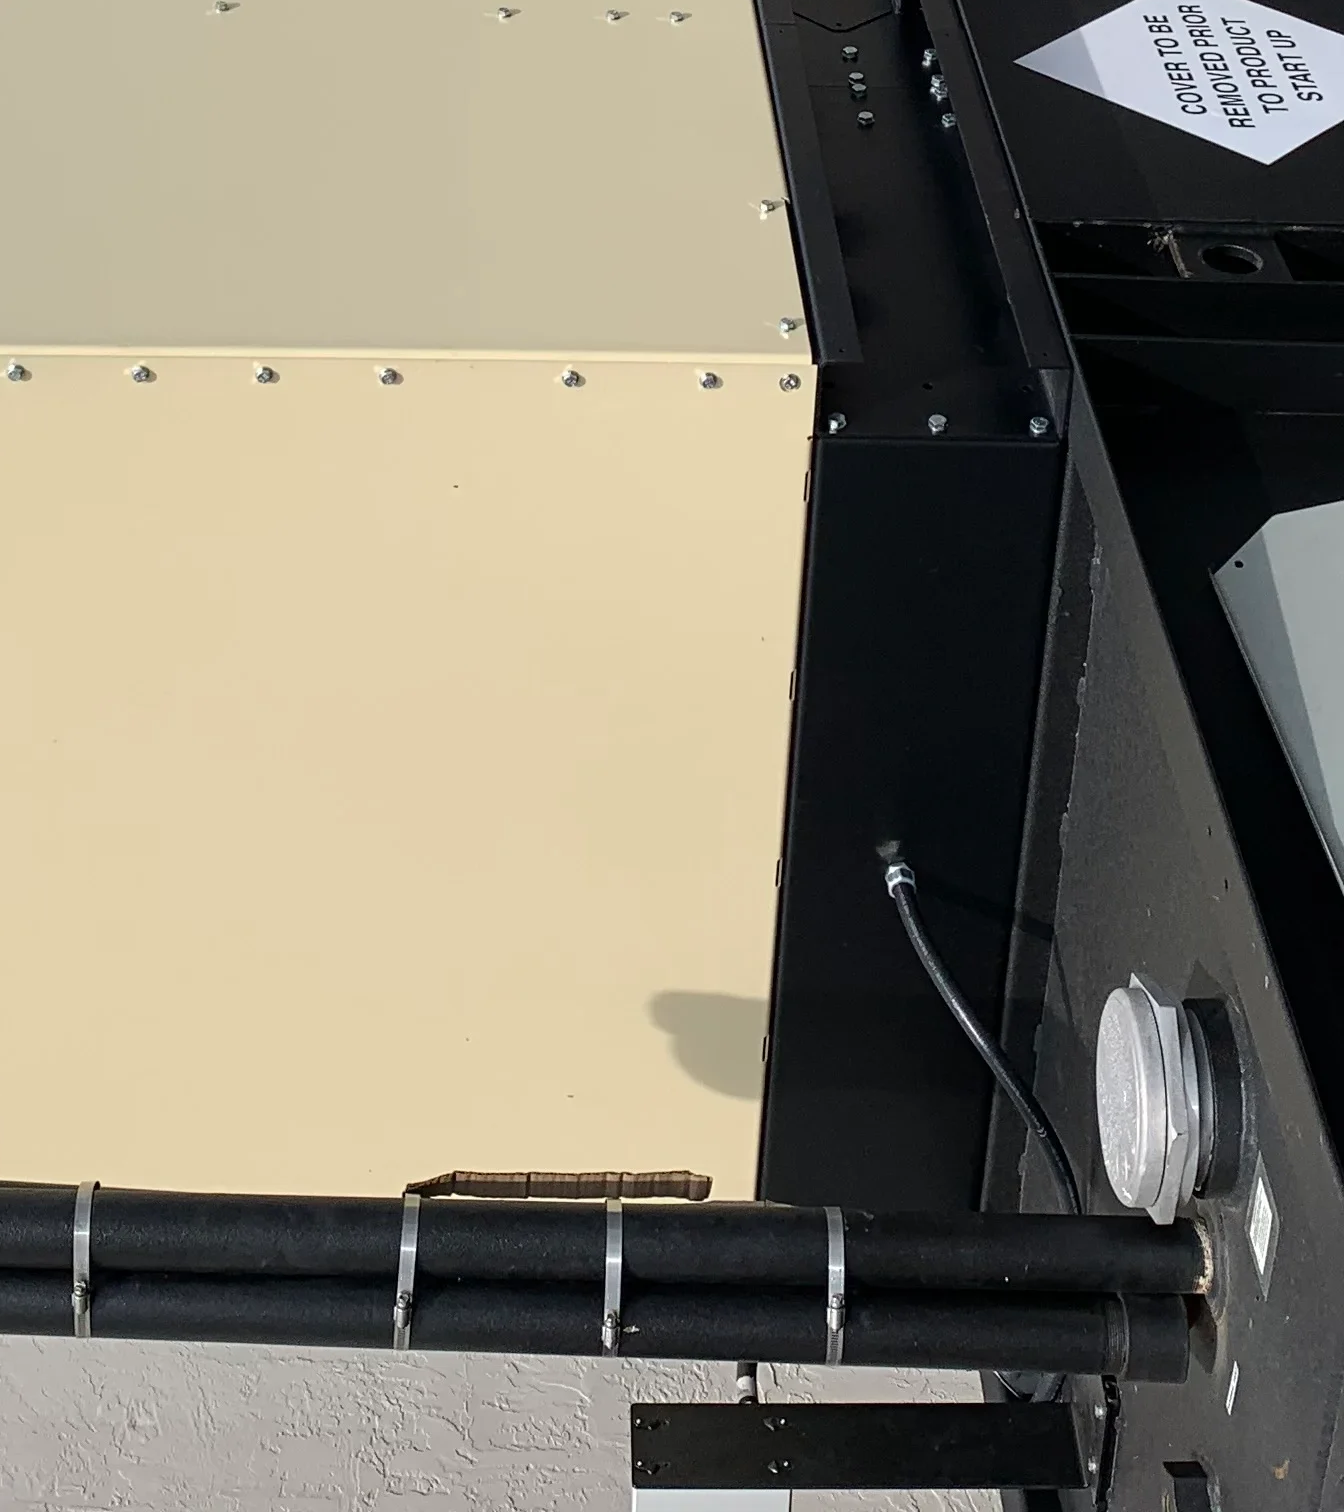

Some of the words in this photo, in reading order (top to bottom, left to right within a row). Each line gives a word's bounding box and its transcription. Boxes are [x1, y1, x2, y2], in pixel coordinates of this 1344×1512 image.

[1142, 14, 1174, 34] BE
[1176, 5, 1218, 47] PRIOR
[1265, 30, 1297, 48] UP
[1153, 38, 1183, 57] TO
[1221, 17, 1277, 88] PRODUCT
[1164, 62, 1207, 114] COVER
[1199, 53, 1256, 129] REMOVED
[1278, 54, 1323, 102] START
[1258, 94, 1289, 115] TO
